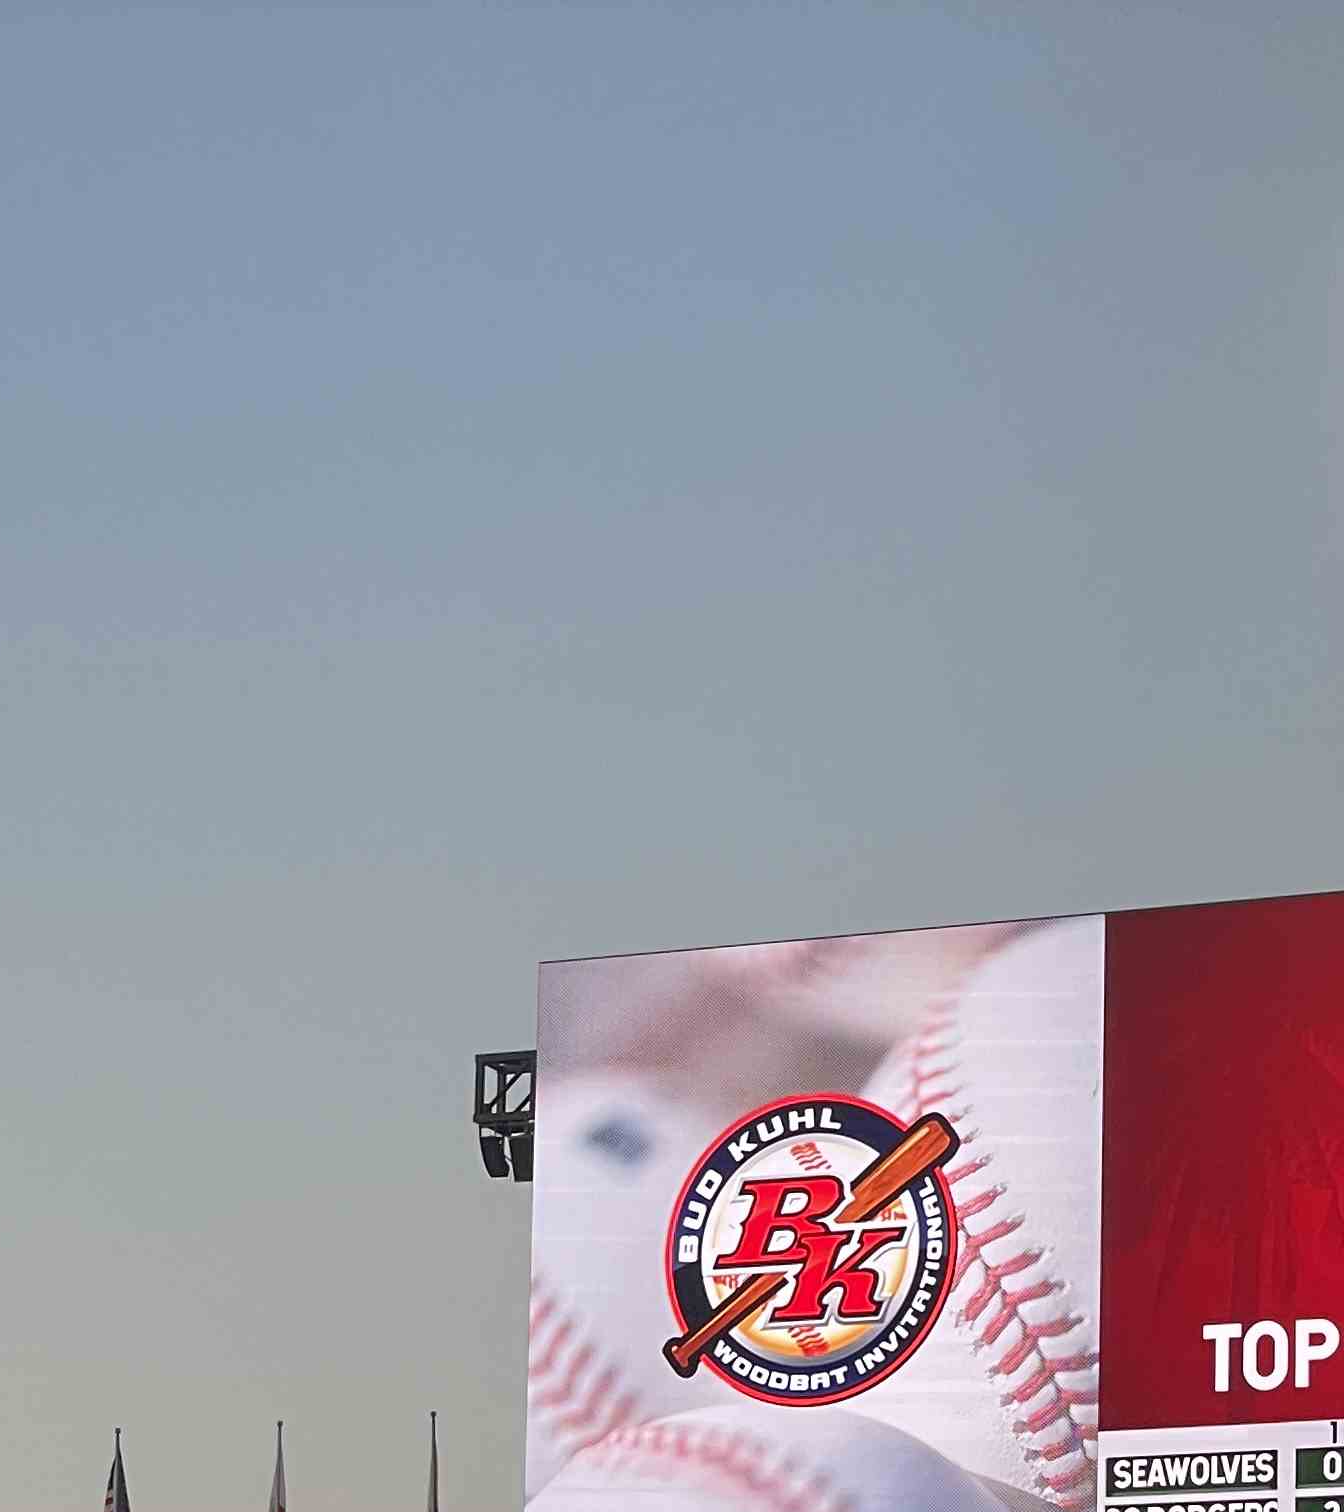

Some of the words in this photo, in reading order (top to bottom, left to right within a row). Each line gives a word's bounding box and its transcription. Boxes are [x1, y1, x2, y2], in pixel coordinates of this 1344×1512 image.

[678, 1168, 723, 1263] BUD
[728, 1108, 843, 1162] KUHL
[713, 1339, 849, 1391] WOODBAT
[854, 1176, 944, 1375] INVITATIONAL
[1201, 1319, 1340, 1393] TOP
[1113, 1451, 1275, 1489] SEAWOLVES
[1322, 1449, 1343, 1481] 0
[1329, 1421, 1339, 1445] 1
